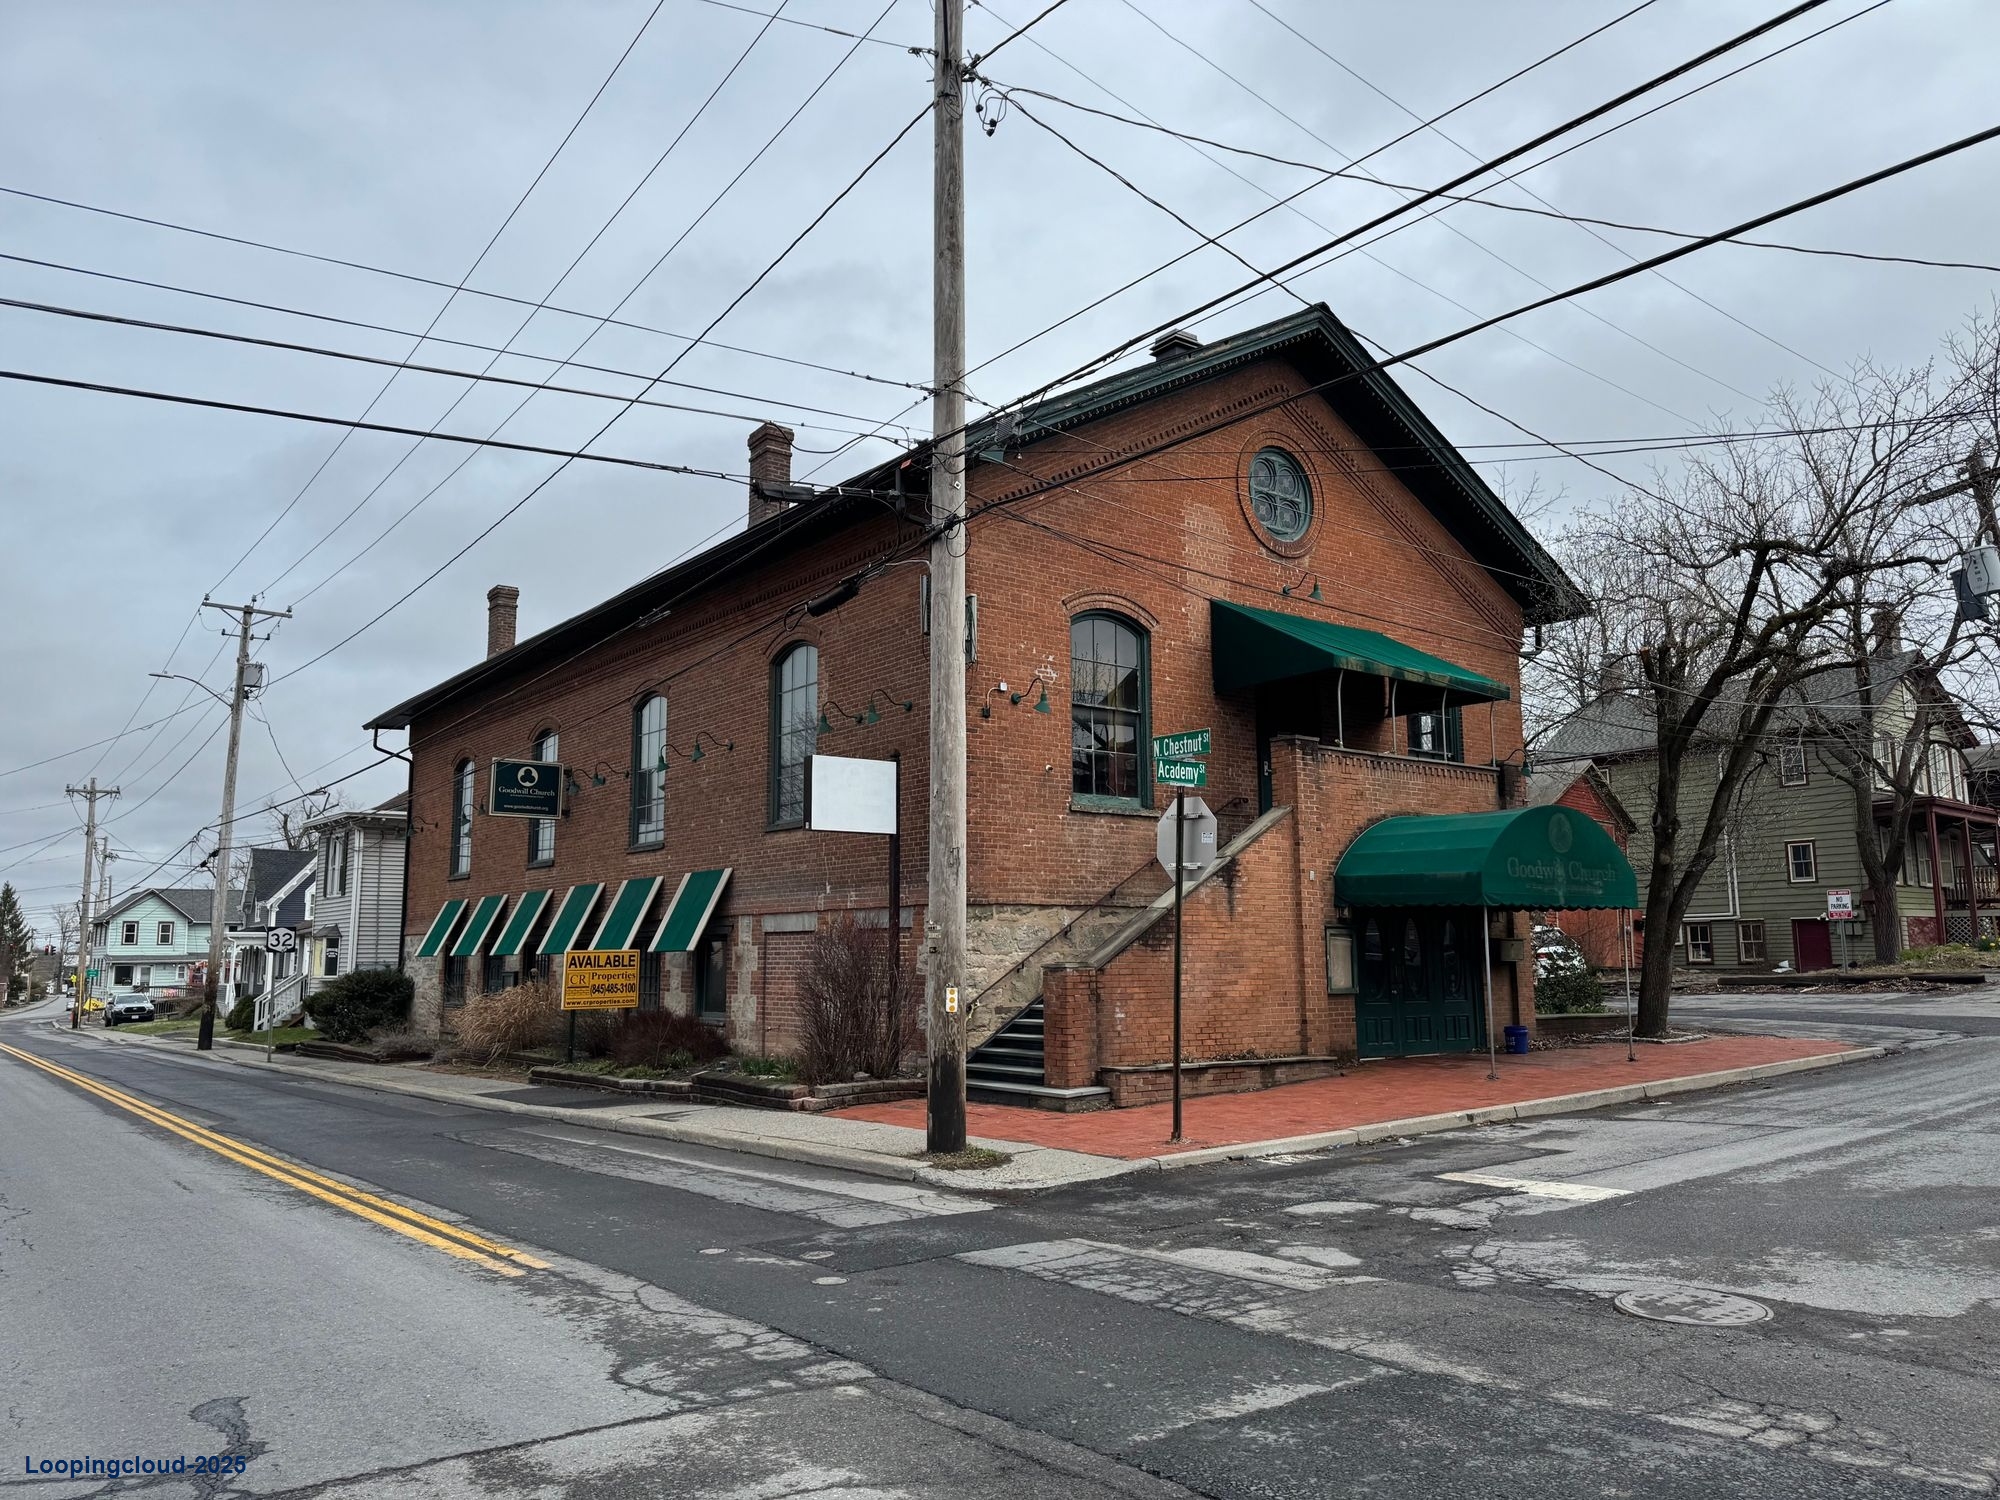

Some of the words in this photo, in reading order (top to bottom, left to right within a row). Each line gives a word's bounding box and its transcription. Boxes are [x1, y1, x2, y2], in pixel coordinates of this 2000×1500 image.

[1153, 740, 1163, 757] N.
[1163, 733, 1202, 756] Chestnut
[1202, 732, 1209, 743] St
[1157, 760, 1199, 784] Academy
[1199, 763, 1205, 773] St
[498, 786, 529, 795] Goodwill
[529, 788, 555, 797] Church
[1568, 861, 1616, 881] Church
[270, 932, 293, 947] 32
[568, 954, 636, 969] AVAILABLE
[569, 974, 587, 985] CR
[591, 971, 636, 981] Properties
